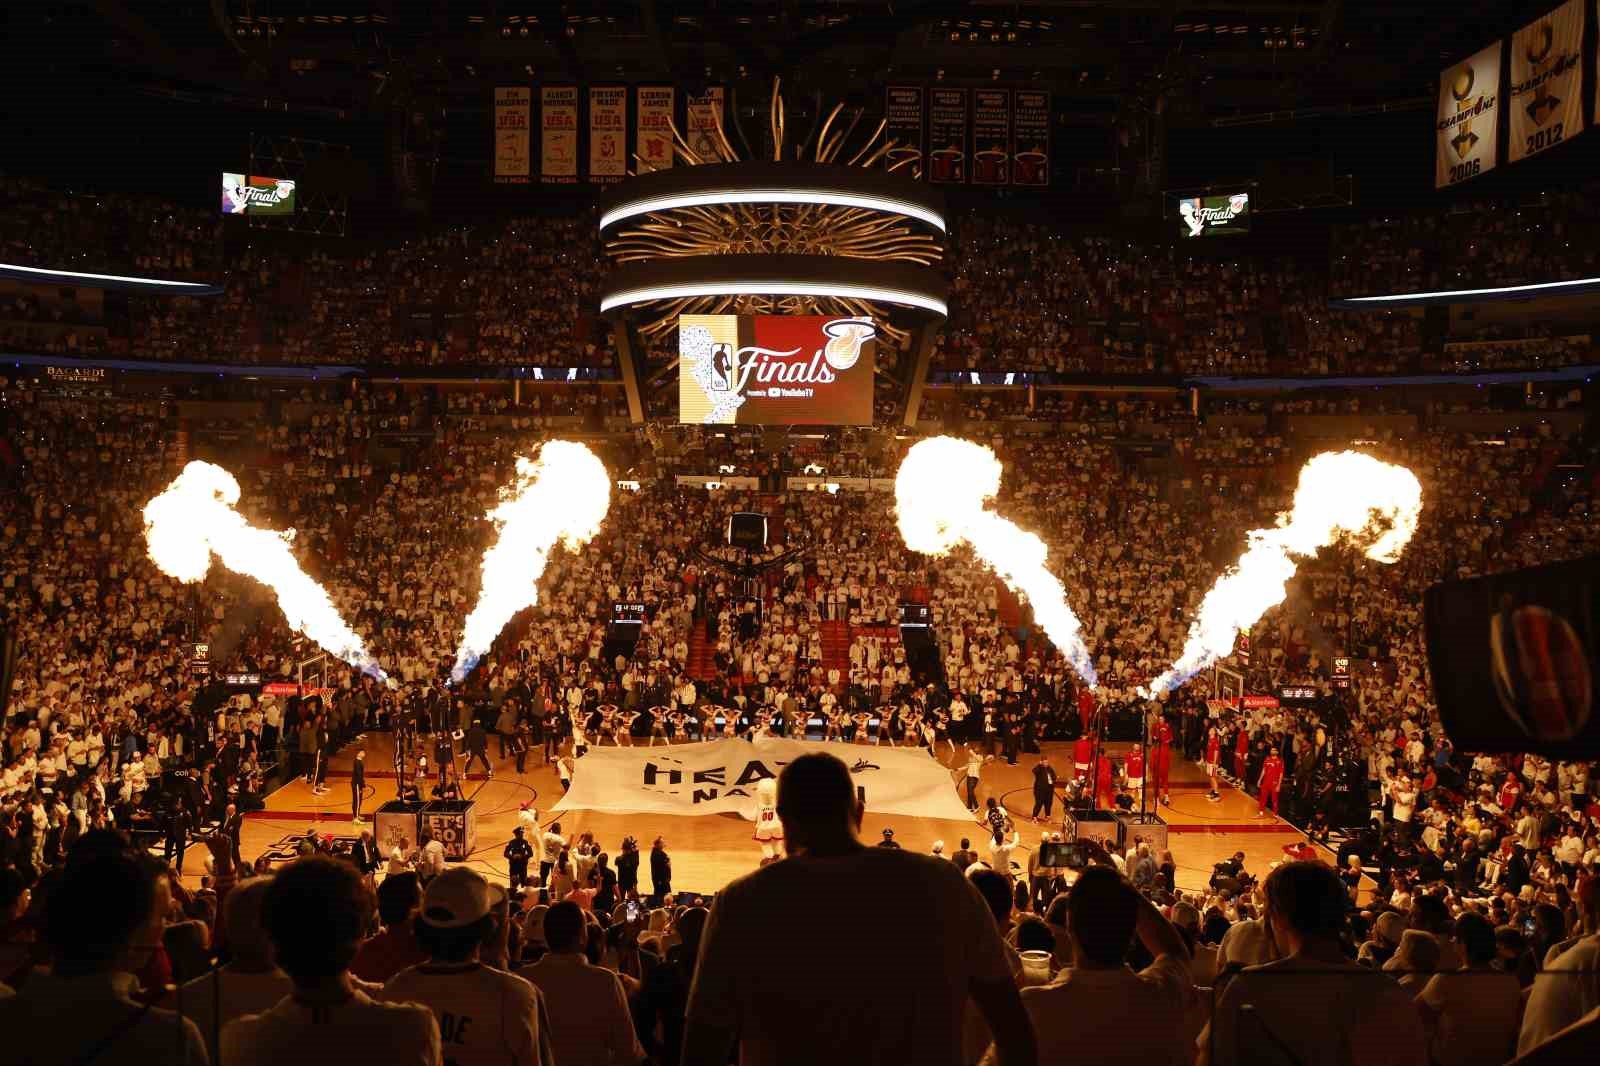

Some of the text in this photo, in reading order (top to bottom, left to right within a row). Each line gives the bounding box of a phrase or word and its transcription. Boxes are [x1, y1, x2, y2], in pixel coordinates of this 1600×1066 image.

[545, 115, 574, 126] USA
[594, 115, 622, 126] USA
[642, 115, 668, 127] USA
[1526, 122, 1564, 155] 2012
[1449, 157, 1480, 184] 2006
[1200, 207, 1235, 224] Finals
[47, 366, 105, 377] BACARDI
[736, 346, 835, 396] Finals
